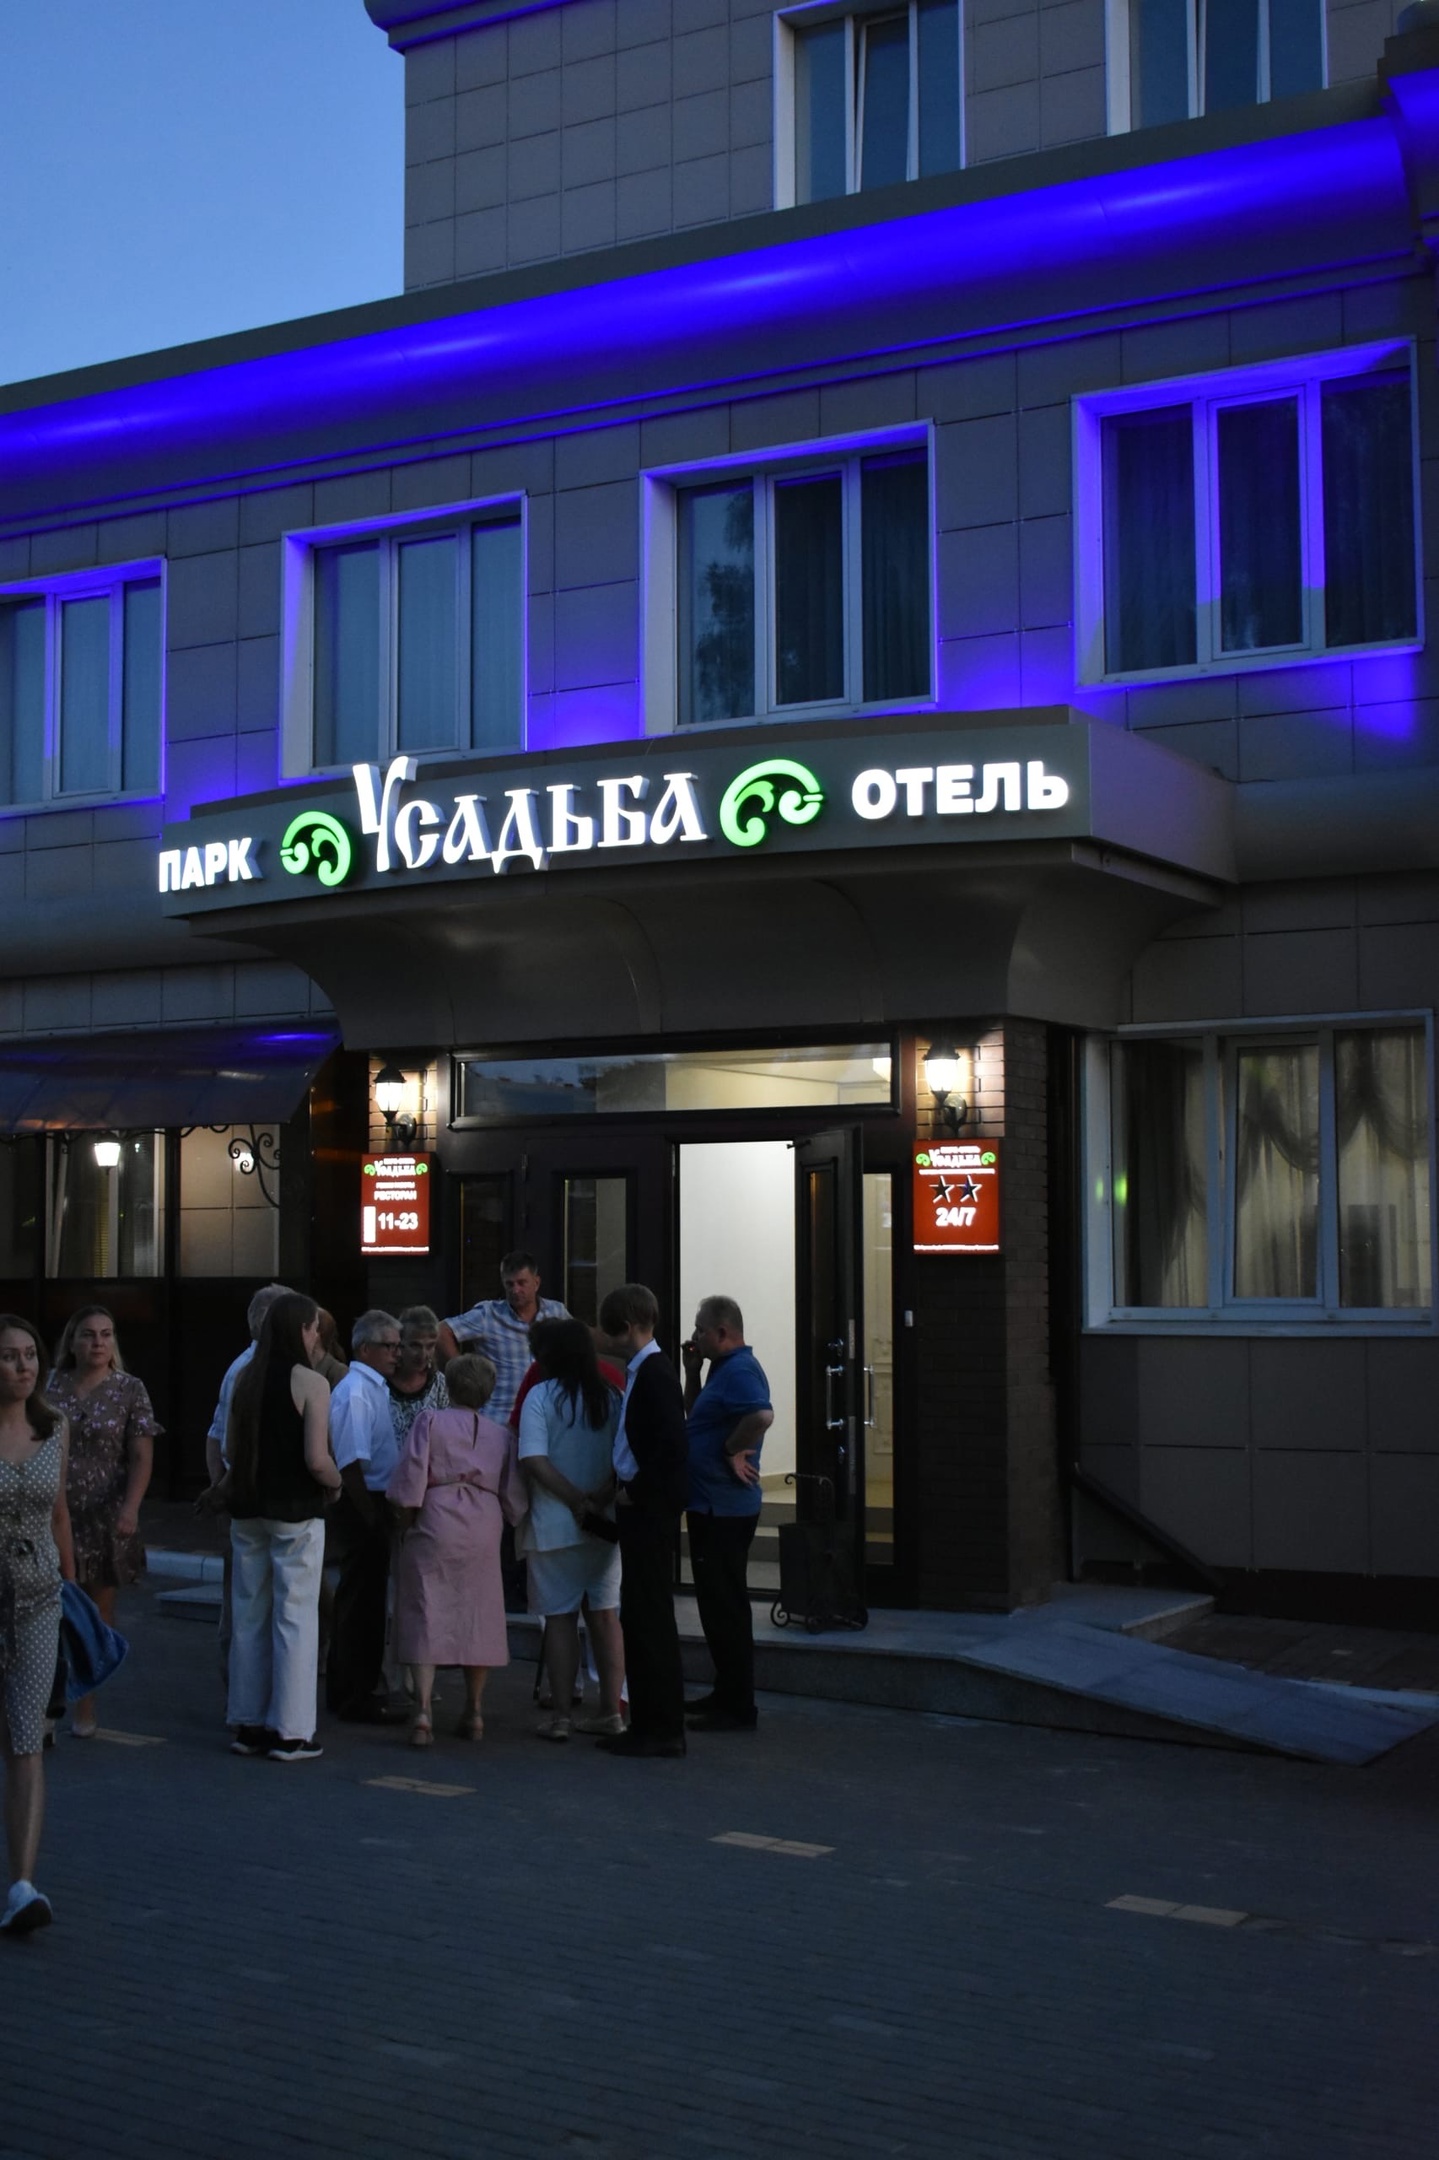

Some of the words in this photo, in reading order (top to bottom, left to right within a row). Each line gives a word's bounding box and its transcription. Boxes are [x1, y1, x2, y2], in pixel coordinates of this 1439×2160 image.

[158, 837, 254, 893] ПАРК
[850, 760, 1070, 820] ОТЕЛЬ
[377, 1212, 419, 1231] 11-23
[935, 1206, 977, 1227] 24/7
